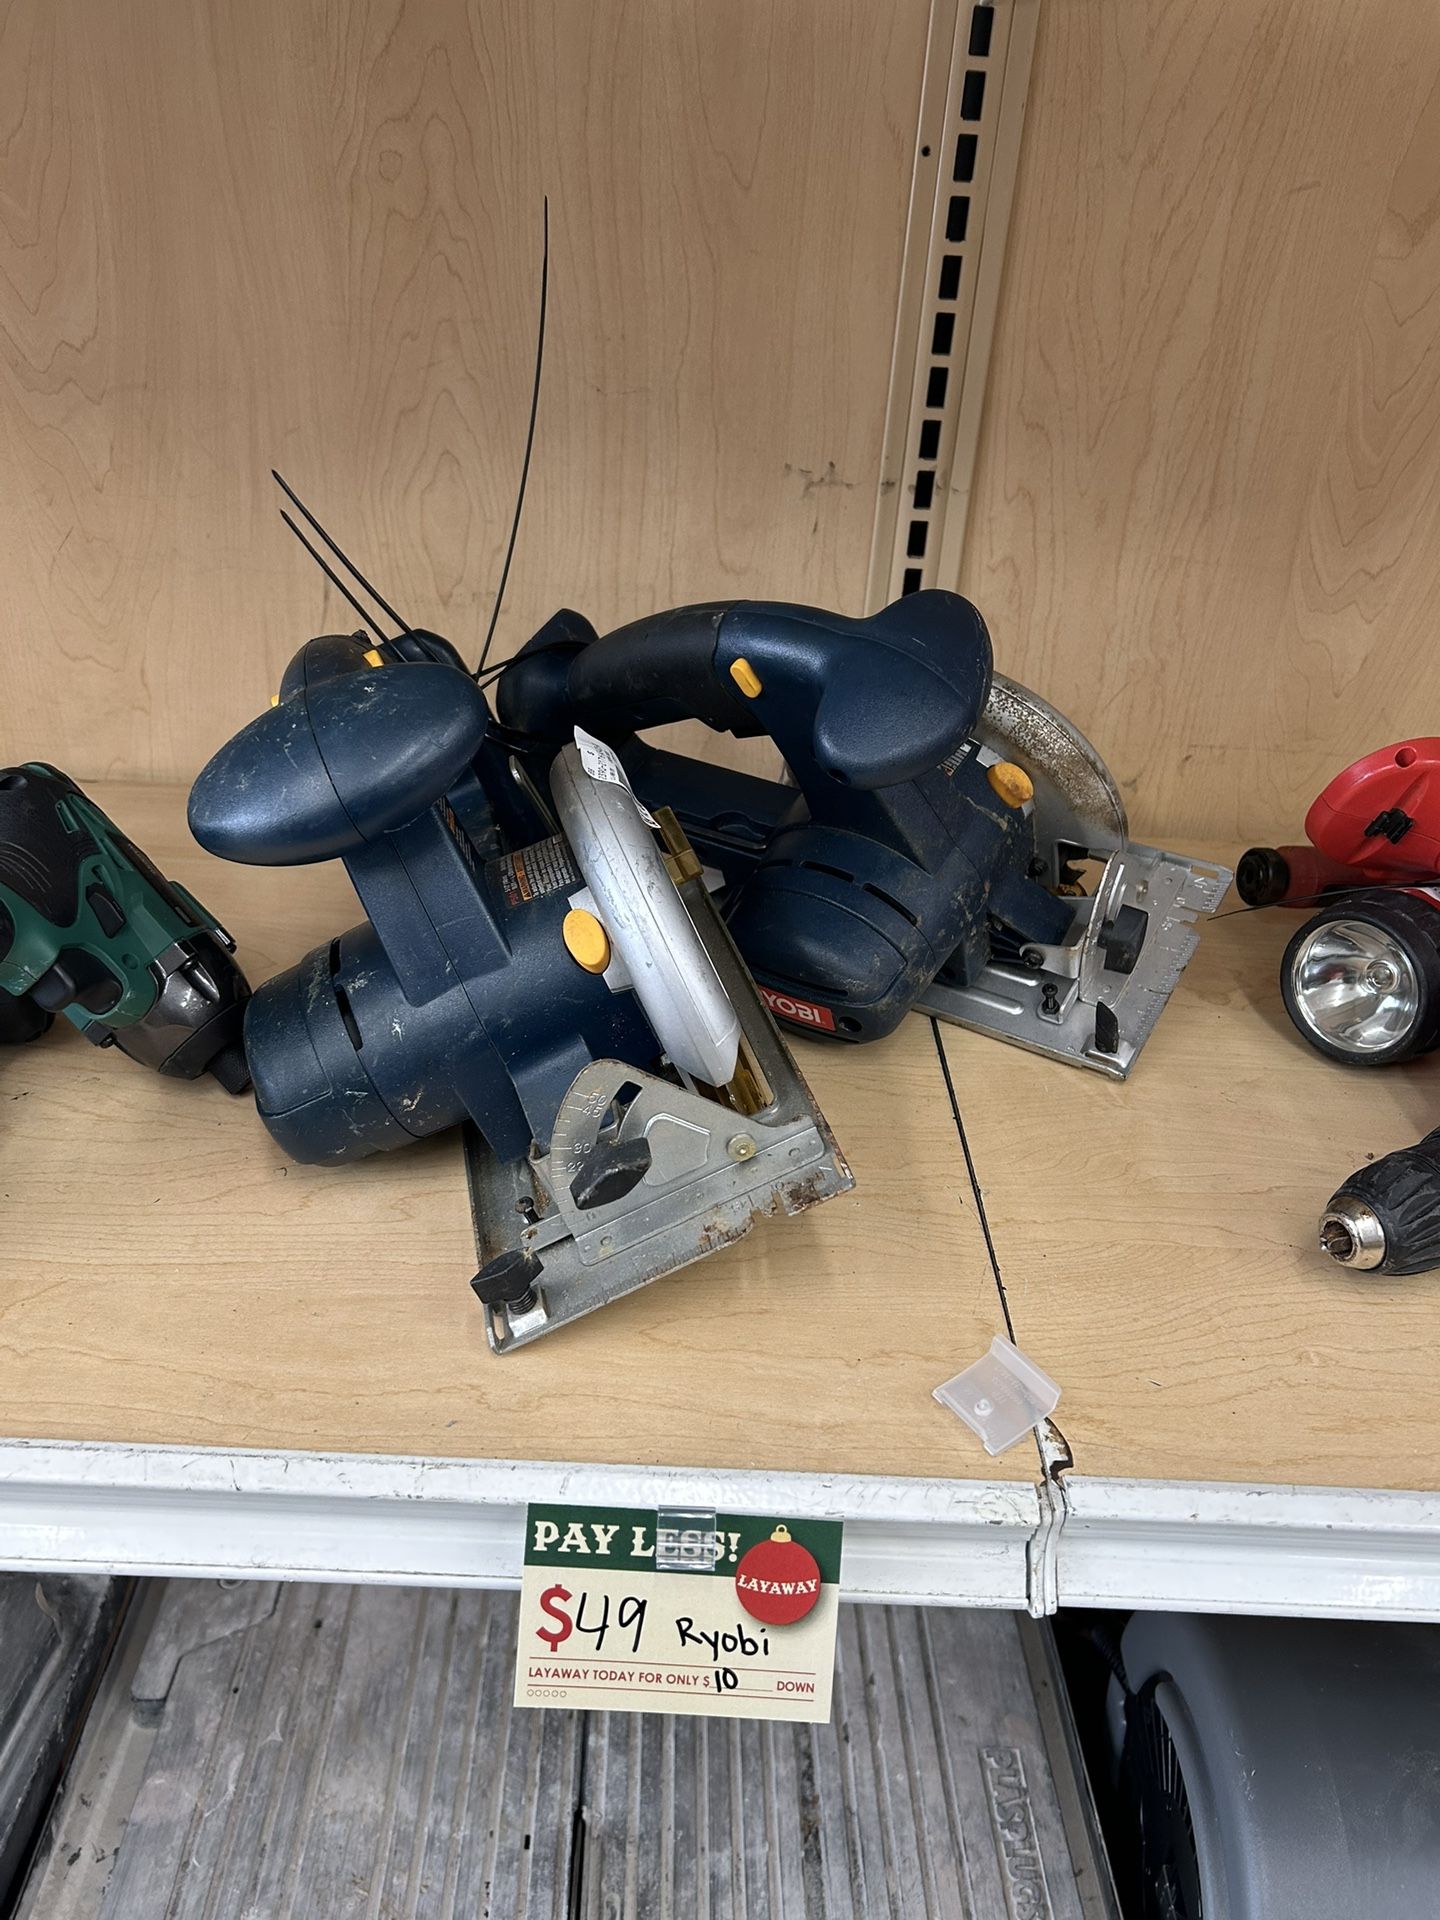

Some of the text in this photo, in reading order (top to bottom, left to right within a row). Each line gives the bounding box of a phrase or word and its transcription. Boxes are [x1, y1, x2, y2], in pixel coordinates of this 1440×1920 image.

[760, 990, 821, 1024] YOBI
[582, 1106, 603, 1118] 45
[573, 1143, 592, 1154] 30
[533, 1520, 741, 1562] PAY LESS!
[737, 1574, 817, 1595] LAYAWAY
[536, 1584, 769, 1661] $49 Ryobi
[528, 1667, 589, 1680] LAYAWAY
[593, 1669, 635, 1682] TODAY
[638, 1672, 662, 1684] FOR
[666, 1674, 699, 1686] ONLY
[776, 1680, 816, 1694] DOWN
